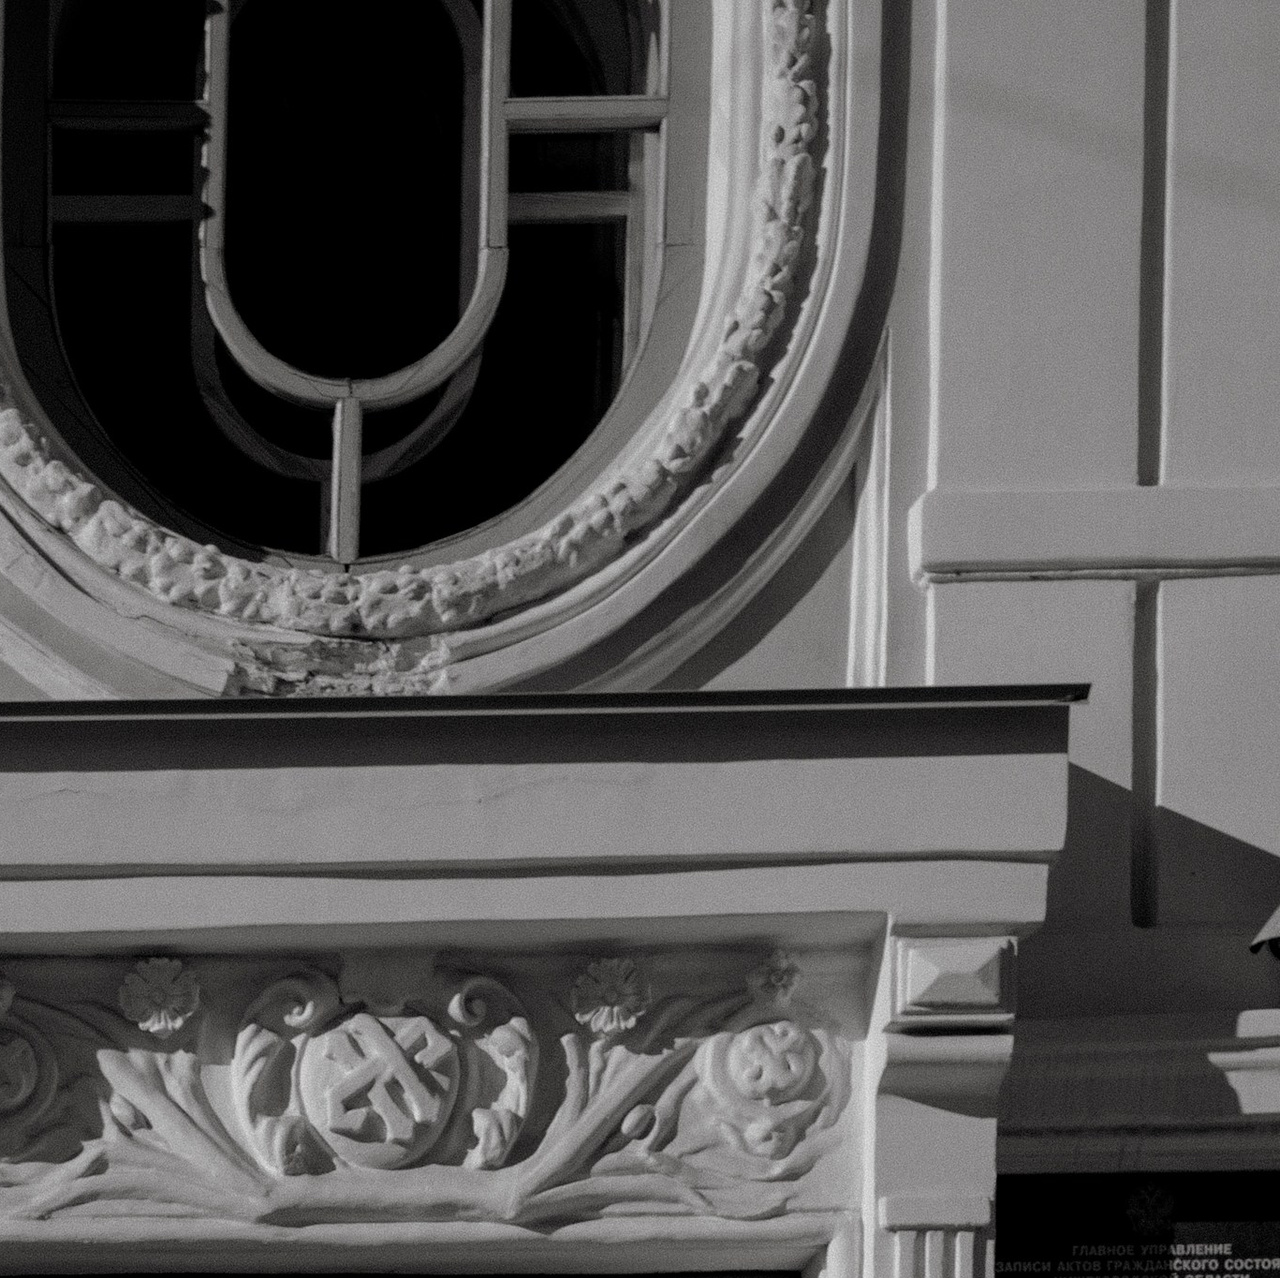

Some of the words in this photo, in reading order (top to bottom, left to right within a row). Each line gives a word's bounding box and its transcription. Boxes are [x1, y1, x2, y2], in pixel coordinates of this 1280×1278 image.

[1072, 1245, 1135, 1256] ГЛАВНОЕ
[1140, 1243, 1233, 1256] УПРАВЛЕНИЕ
[995, 1261, 1051, 1273] ЗАПИСИ
[1057, 1260, 1102, 1272] АКТОВ
[1106, 1258, 1219, 1272] ГРАЖДАНСКОГО
[1224, 1258, 1280, 1271] СОСТОЯ
